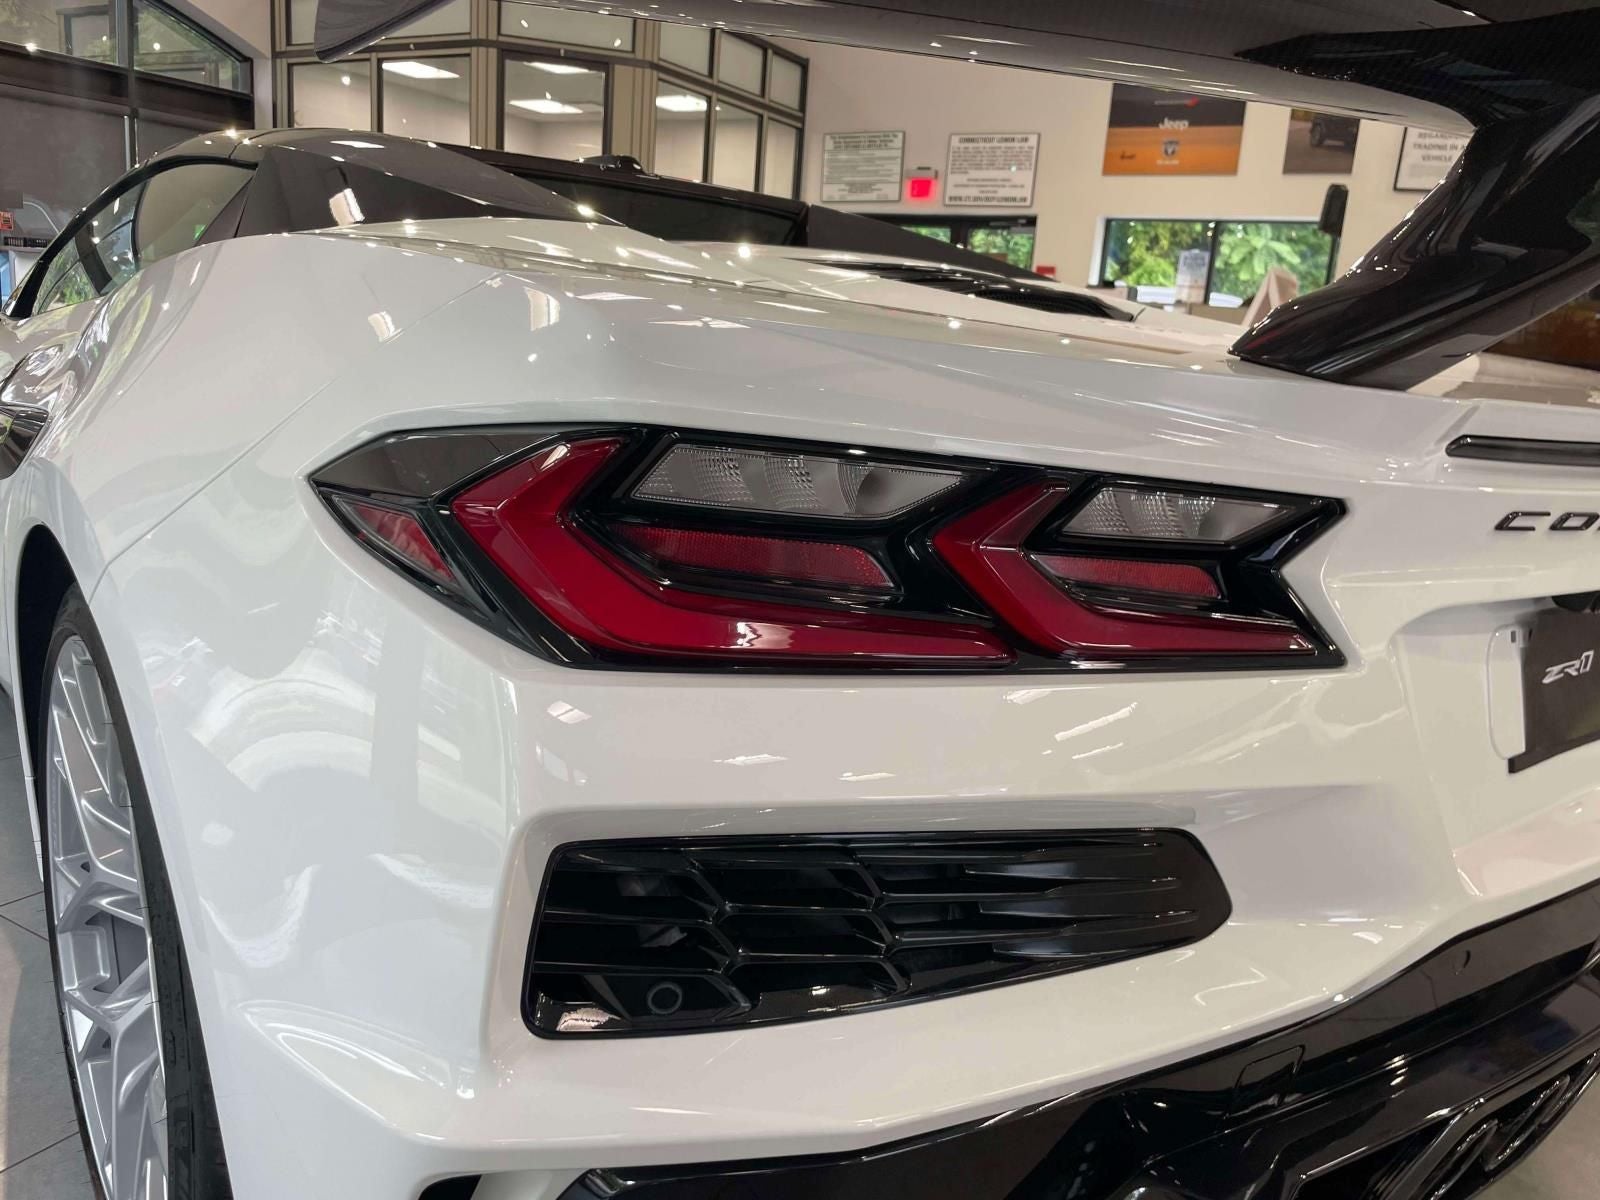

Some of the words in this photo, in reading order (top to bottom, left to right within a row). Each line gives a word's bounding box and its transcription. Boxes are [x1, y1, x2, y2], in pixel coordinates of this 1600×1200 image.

[1158, 117, 1189, 130] Jeep
[1412, 143, 1448, 151] TRADING
[1449, 143, 1458, 151] IN
[1421, 154, 1453, 162] VEHICLE
[1494, 510, 1600, 532] CO
[1542, 649, 1595, 684] ZR1
